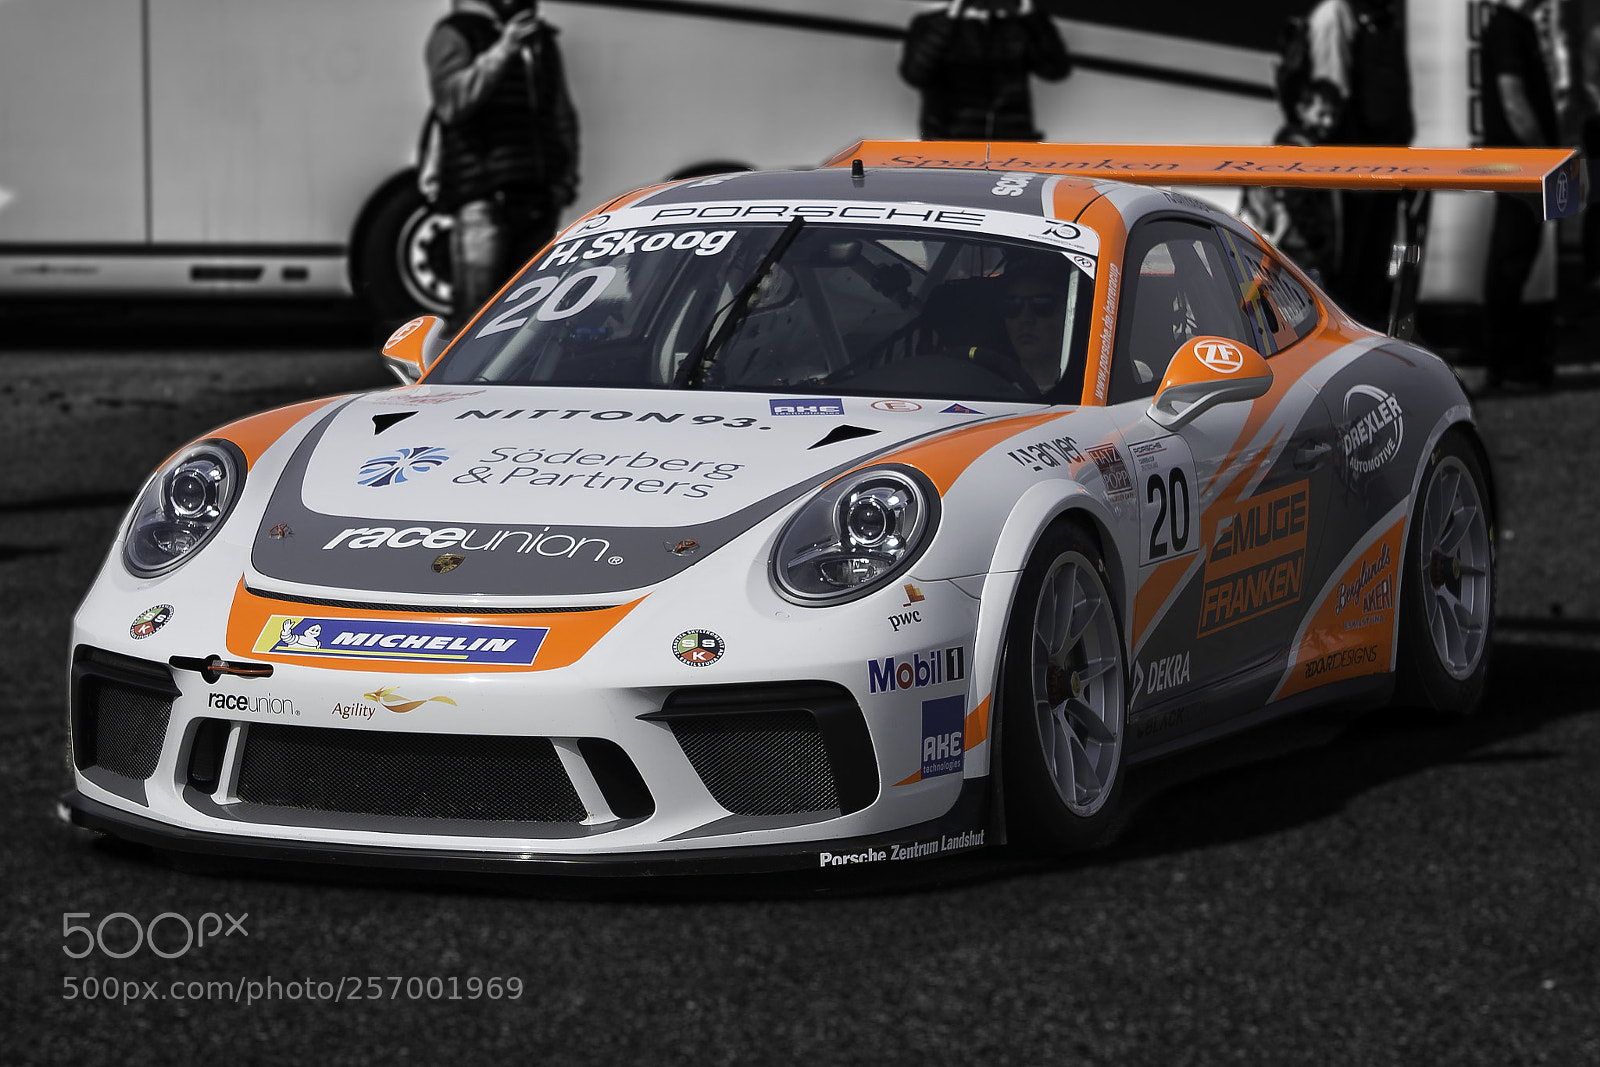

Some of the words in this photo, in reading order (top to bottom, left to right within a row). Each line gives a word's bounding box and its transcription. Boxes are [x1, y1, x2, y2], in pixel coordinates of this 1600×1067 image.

[881, 154, 1179, 170] Sparbanken
[1213, 160, 1431, 175] Rekarne
[651, 206, 986, 226] PORSCHE
[475, 266, 617, 339] 20
[1095, 262, 1121, 400] www.porsche.de/carreracup
[1196, 343, 1241, 367] ZF
[1343, 396, 1402, 456] DREXLER
[480, 446, 746, 481] Söderberg
[1349, 437, 1396, 473] AUTOMOTIVE
[452, 466, 494, 484] &
[500, 467, 714, 499] Partners
[1147, 467, 1189, 560] 20
[1210, 490, 1306, 563] EMUGE
[1201, 556, 1302, 628] FRANKEN
[888, 607, 922, 632] pwc
[331, 631, 518, 653] MICHELIN
[868, 649, 943, 695] Mobil
[1146, 650, 1191, 695] DEKRA
[332, 701, 376, 721] Agility
[923, 731, 962, 763] AKE
[923, 759, 961, 774] technologies
[820, 848, 887, 868] Porsche
[891, 842, 939, 862] Zentrum
[940, 829, 984, 852] Landshut
